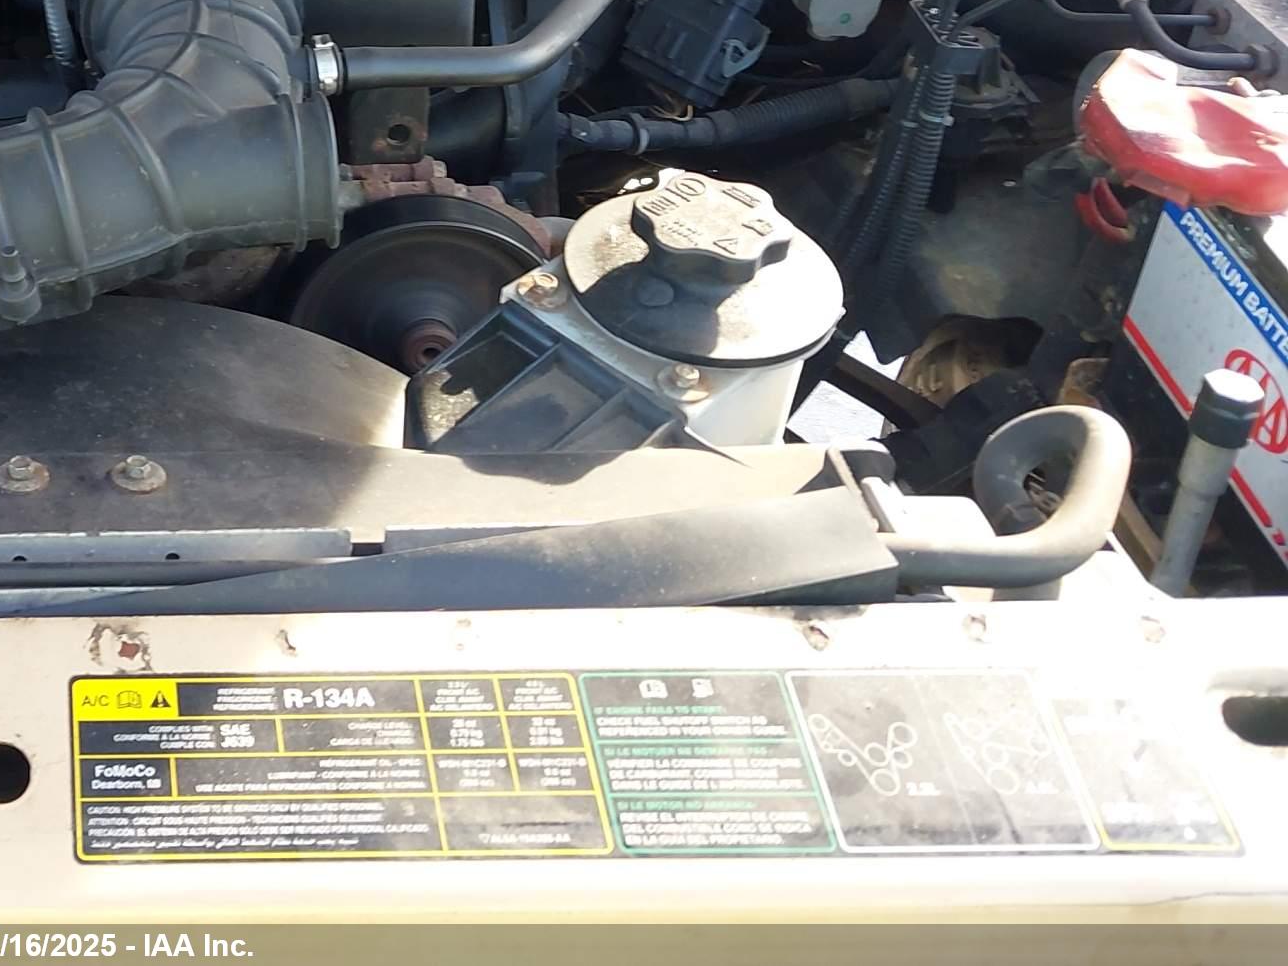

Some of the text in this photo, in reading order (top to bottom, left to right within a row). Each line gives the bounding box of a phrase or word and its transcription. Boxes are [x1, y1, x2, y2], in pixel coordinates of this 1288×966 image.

[1180, 211, 1249, 296] PREMIUM
[82, 694, 110, 707] A/C
[283, 687, 375, 708] R-134A
[220, 723, 251, 736] SAE
[95, 764, 156, 778] FoMoCo
